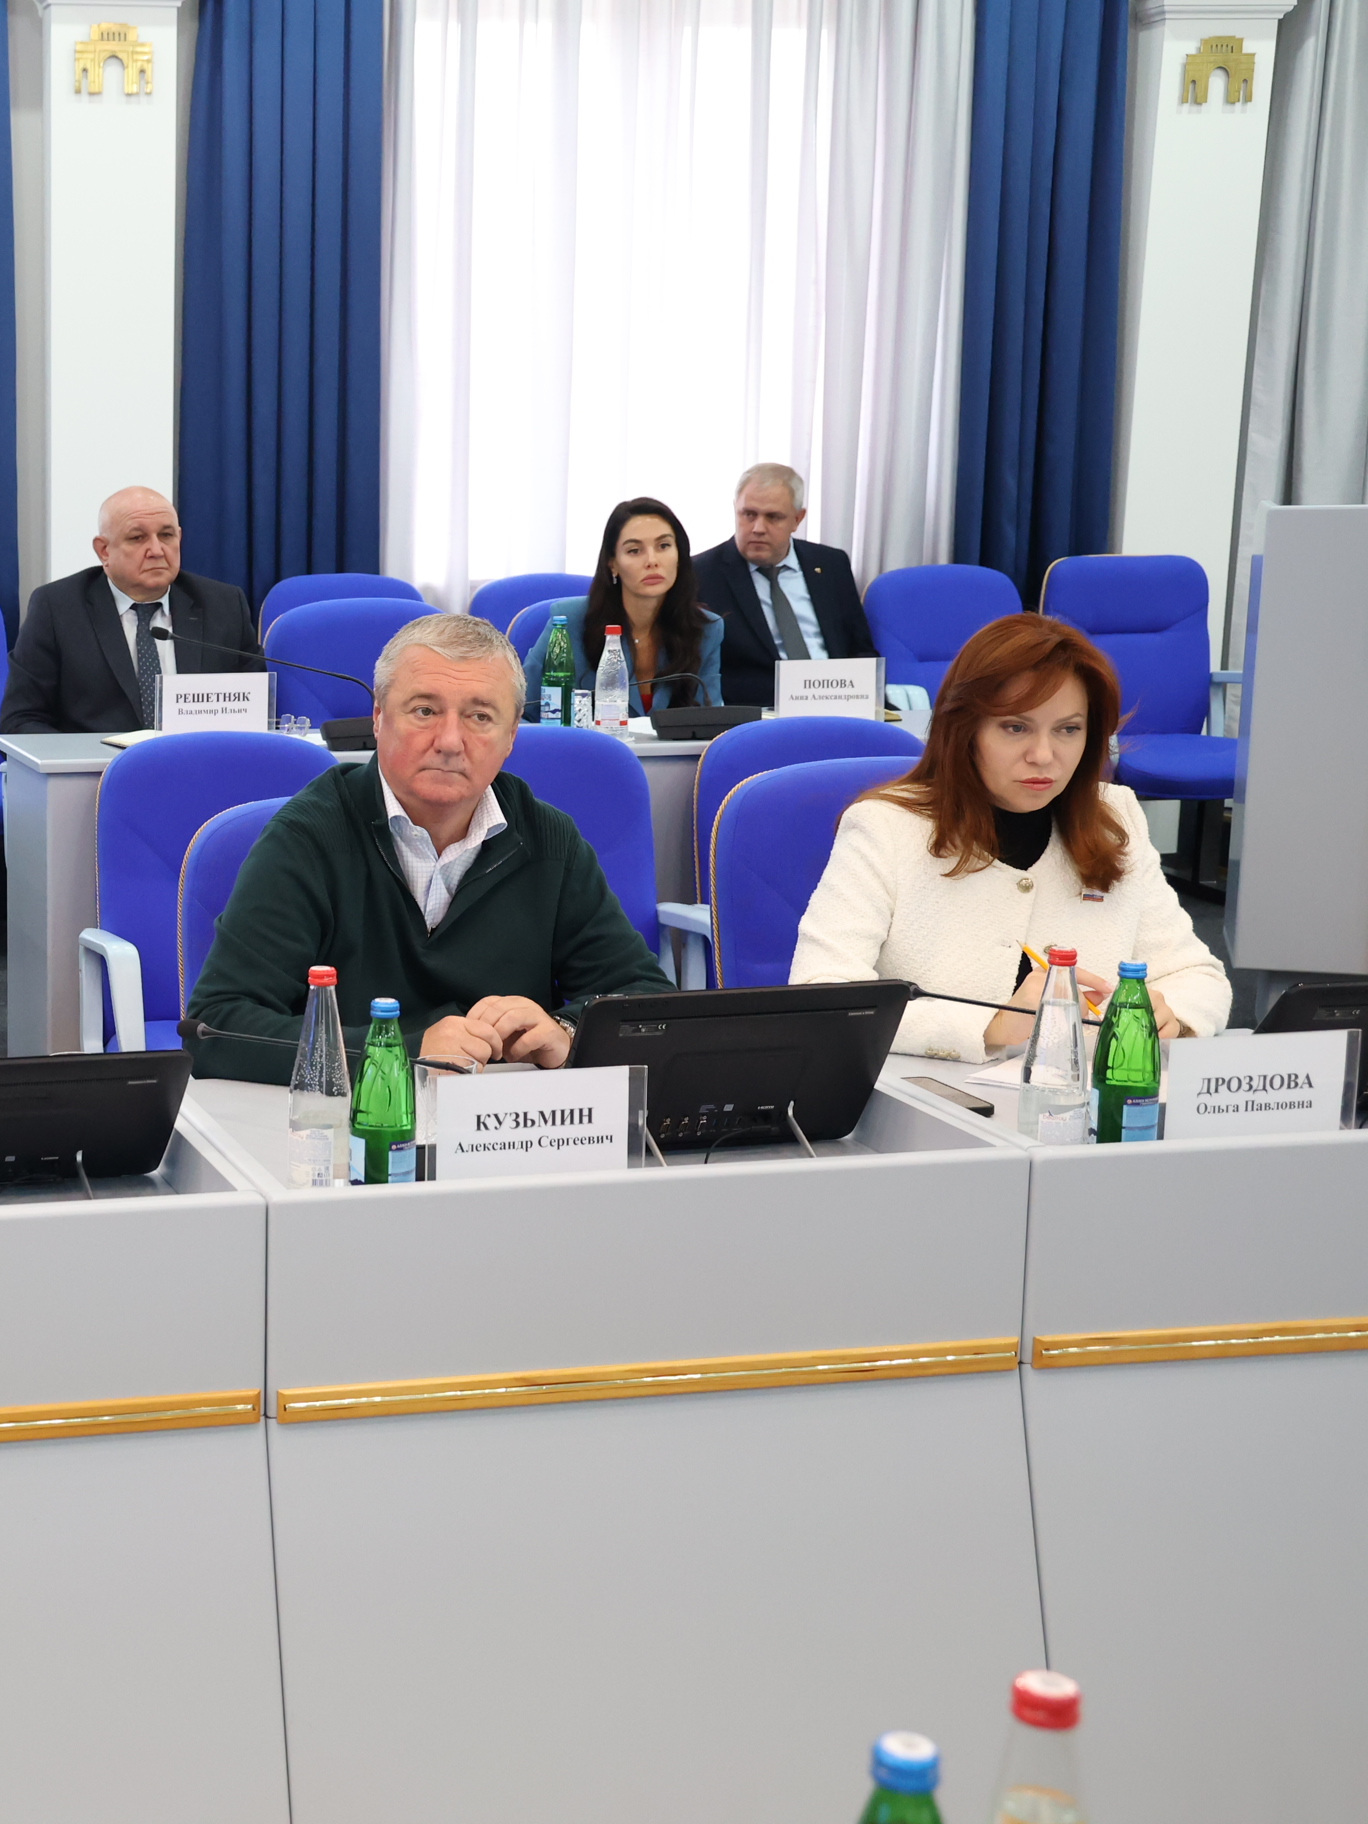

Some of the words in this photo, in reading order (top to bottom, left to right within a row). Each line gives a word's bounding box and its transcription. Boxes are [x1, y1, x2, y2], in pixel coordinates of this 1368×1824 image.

[803, 679, 855, 689] ПОПОВА
[175, 692, 251, 703] РЕШЕТНЯК
[810, 693, 869, 702] Александровна
[178, 707, 219, 716] Владимир
[221, 706, 248, 714] Ильич
[1196, 1072, 1314, 1098] ДРОЗДОВА
[1196, 1102, 1240, 1115] Ольга
[1244, 1099, 1313, 1113] Павловна
[475, 1106, 594, 1132] КУЗЬМИН
[454, 1138, 534, 1154] Александр
[537, 1135, 613, 1151] Сергеевич
